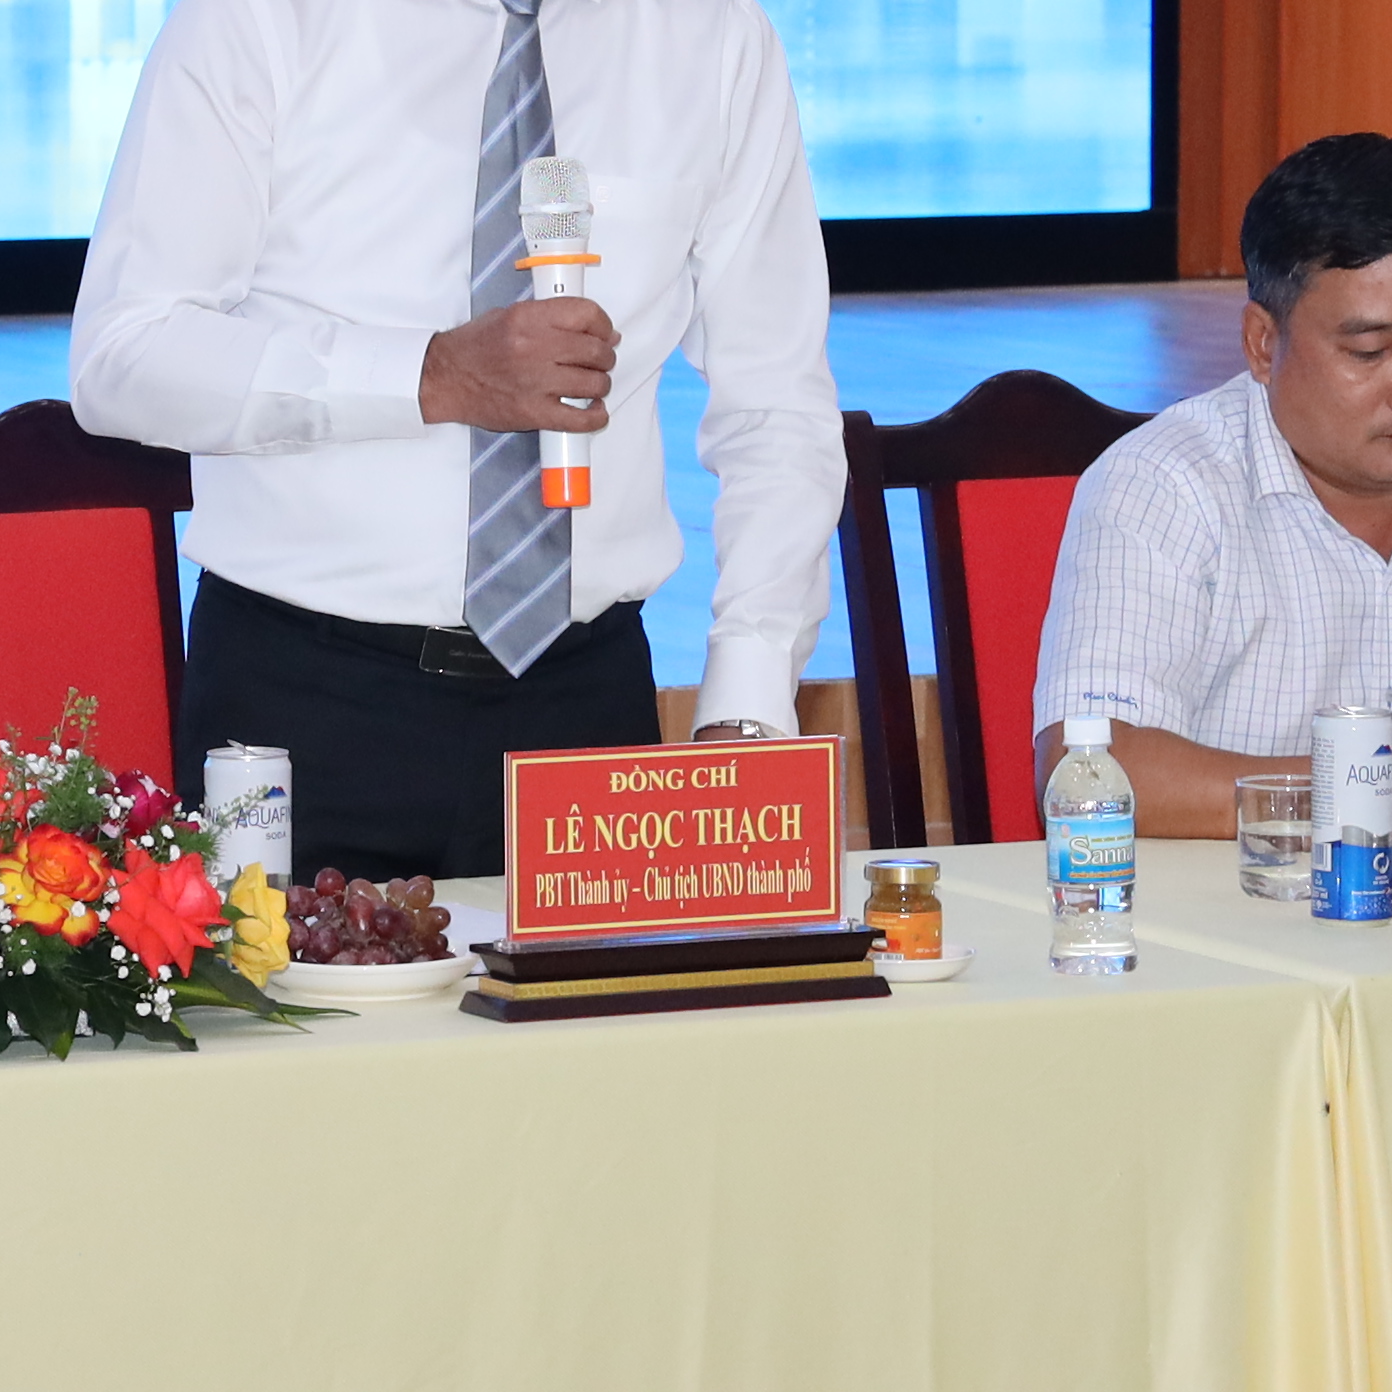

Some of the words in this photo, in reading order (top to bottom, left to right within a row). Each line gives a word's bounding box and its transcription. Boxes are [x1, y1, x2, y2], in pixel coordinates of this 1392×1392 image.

[610, 765, 684, 793] ĐỒNG
[691, 759, 737, 788] CHÍ
[545, 804, 584, 854] LÊ
[593, 810, 684, 859] NGỌC
[692, 804, 802, 853] THẠCH
[536, 873, 564, 907] PBT
[567, 870, 609, 905] Thành
[614, 869, 629, 912] ủy
[644, 866, 671, 901] Chủ
[674, 865, 698, 909] tịch
[702, 862, 743, 898] UBND
[747, 860, 784, 894] thành
[787, 847, 811, 902] phố
